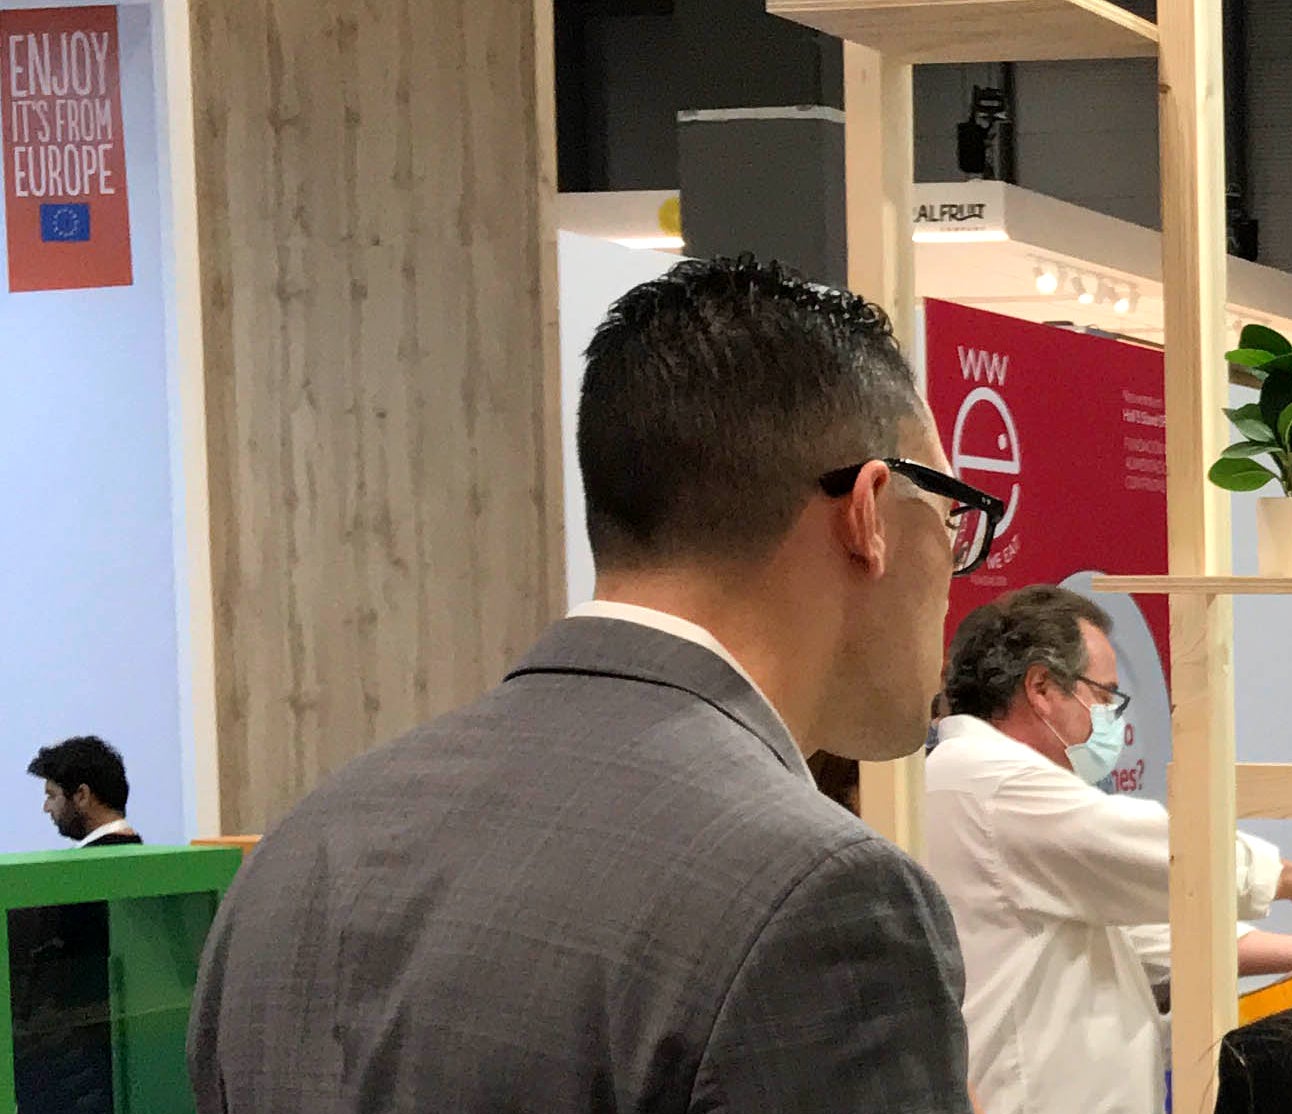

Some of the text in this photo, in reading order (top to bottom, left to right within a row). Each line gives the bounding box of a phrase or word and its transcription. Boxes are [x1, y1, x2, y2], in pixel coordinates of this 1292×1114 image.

[9, 31, 109, 97] ENJOY
[11, 99, 113, 143] IT'S FROM
[14, 143, 115, 197] EUROPE
[912, 203, 987, 222] ALFRUIT
